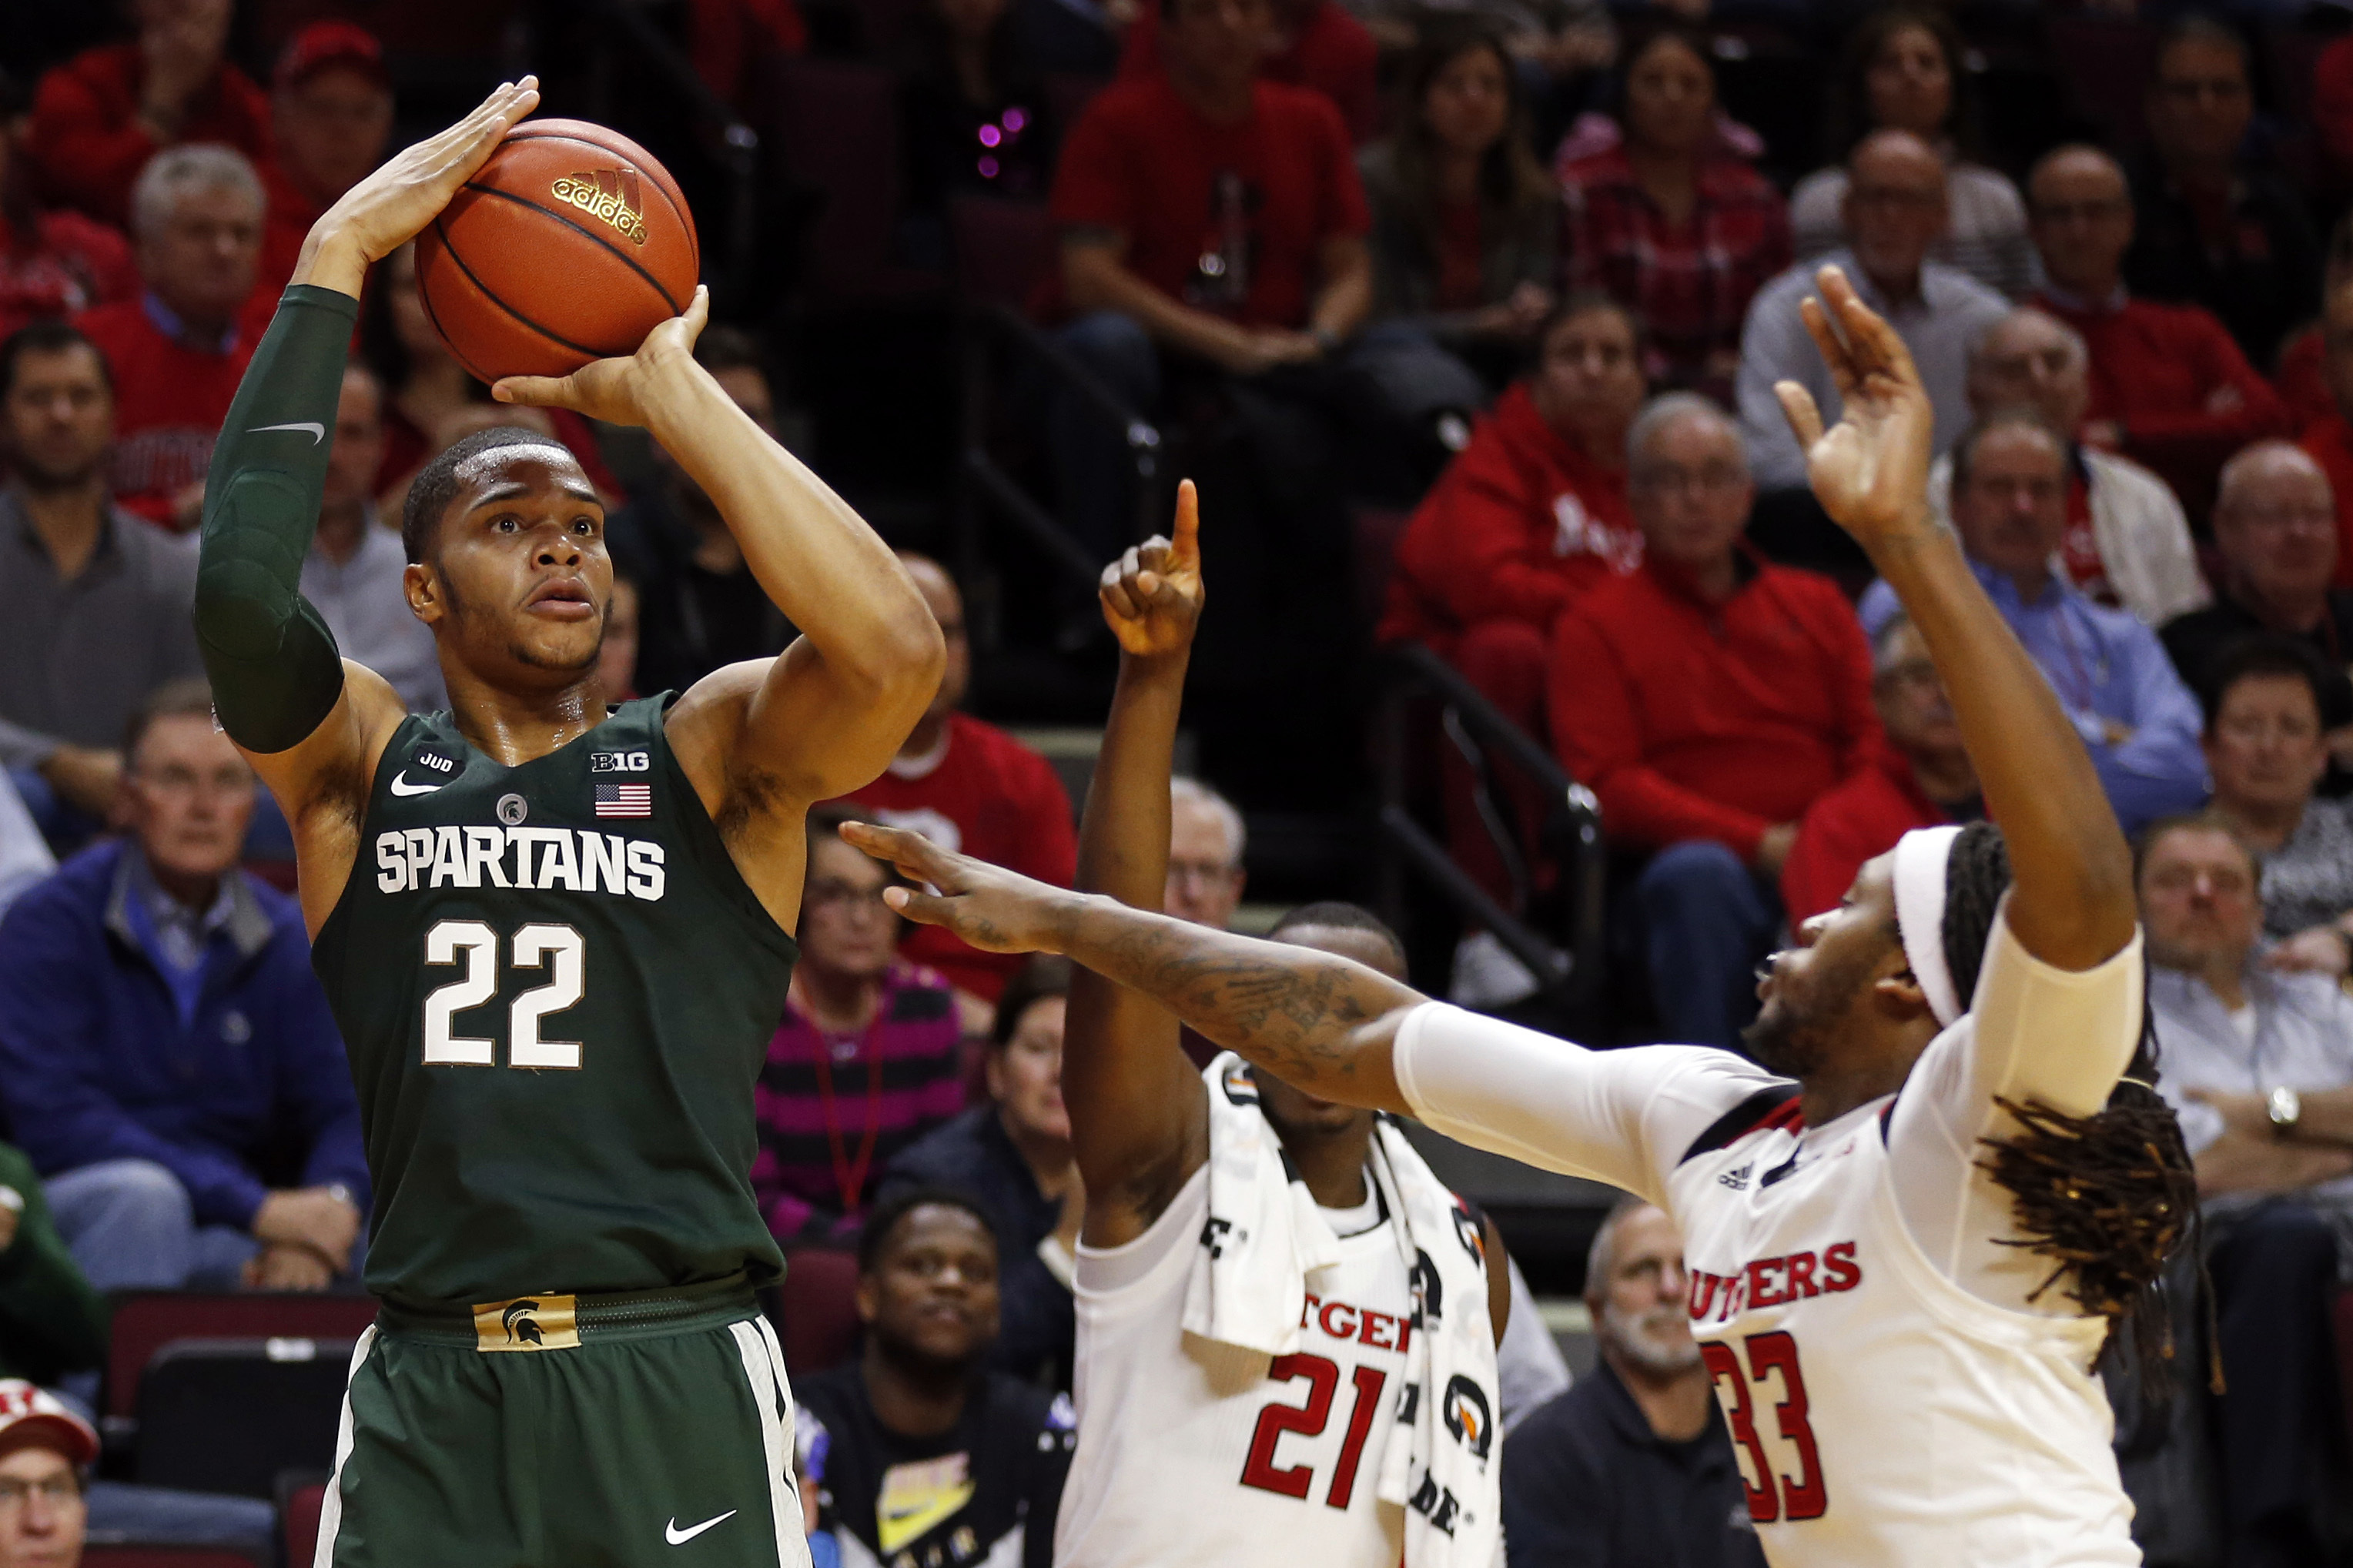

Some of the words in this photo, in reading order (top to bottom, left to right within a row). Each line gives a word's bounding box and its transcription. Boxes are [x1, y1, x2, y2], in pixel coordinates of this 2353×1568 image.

[552, 178, 648, 246] adidas
[420, 753, 454, 773] JUD
[376, 825, 665, 901] SPARTANS
[421, 919, 585, 1069] 22
[1240, 1352, 1387, 1510] 21
[1698, 1330, 1828, 1523] 33
